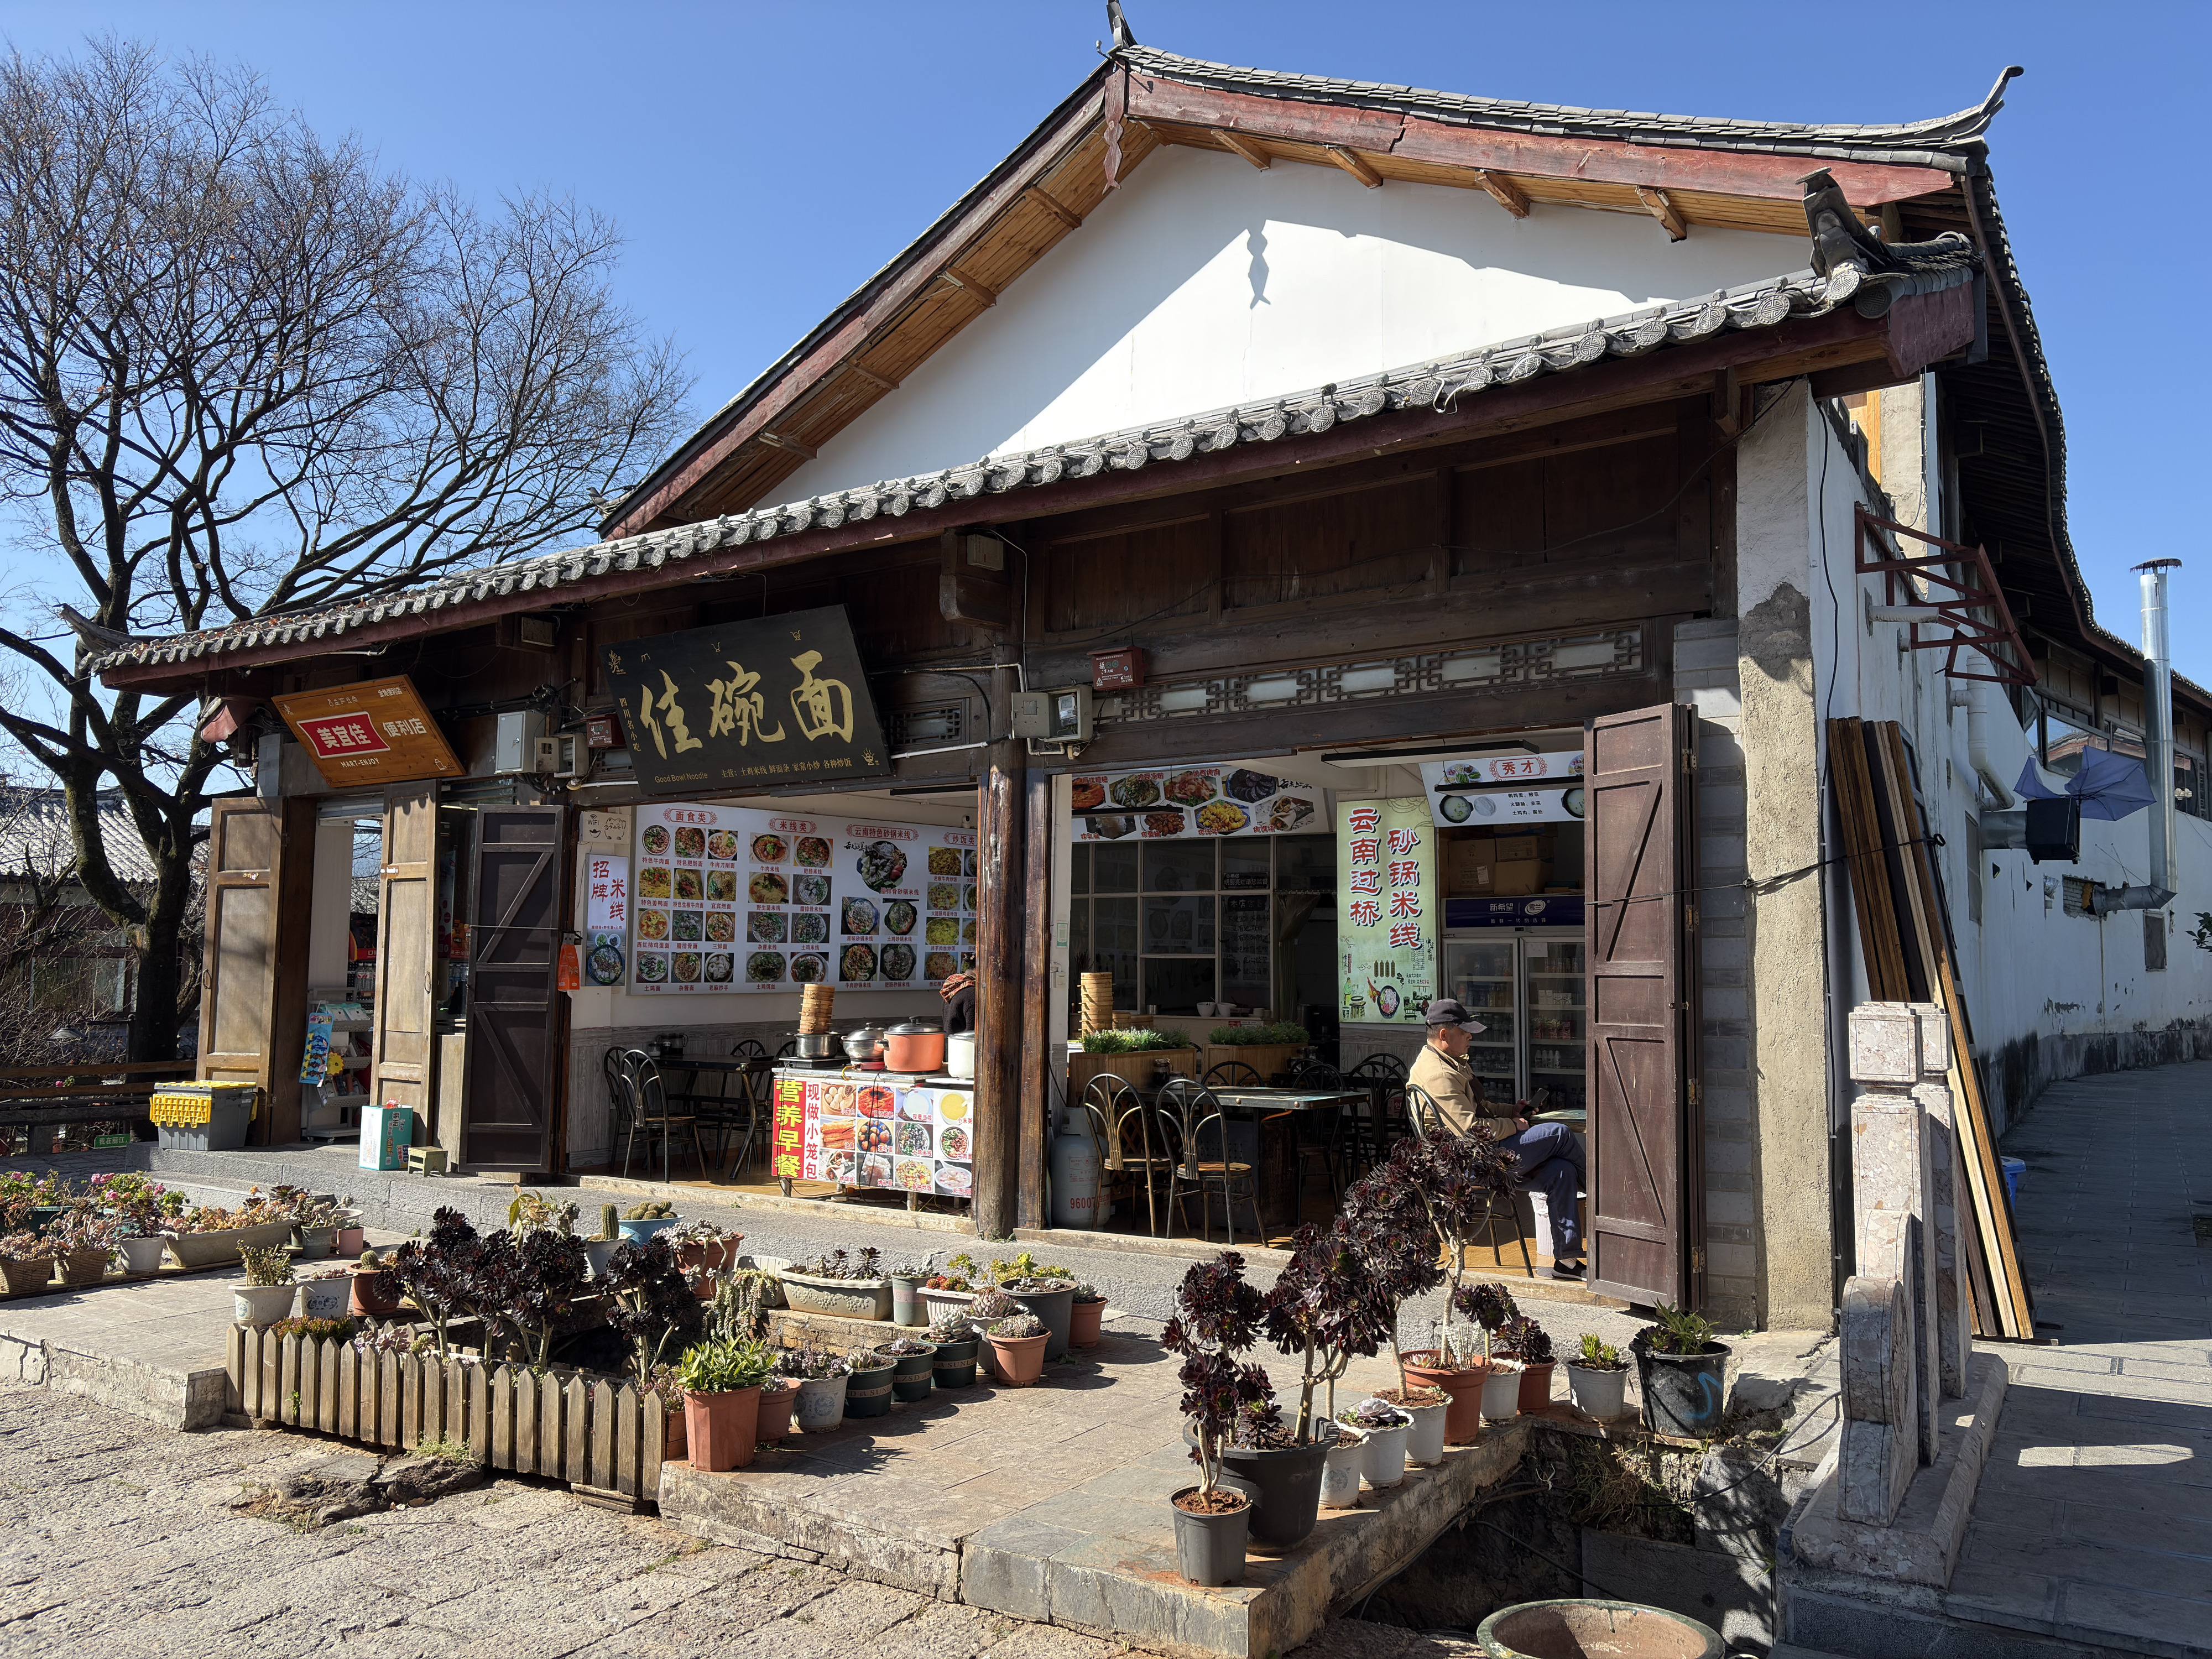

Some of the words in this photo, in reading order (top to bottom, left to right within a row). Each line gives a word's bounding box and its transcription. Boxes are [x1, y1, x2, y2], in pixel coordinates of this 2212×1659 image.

[378, 687, 403, 697] 金角便利店
[640, 650, 853, 760] 佳碗面
[382, 718, 427, 738] 便利店
[619, 697, 641, 753] 四川名小吃
[316, 723, 372, 749] 美宜佳
[340, 757, 380, 768] MART-ENJOY
[740, 766, 768, 777] 土鸡米线
[769, 764, 790, 774] 鲜面条
[792, 761, 820, 773] 家常小炒
[823, 758, 852, 769] 各种炒饭
[1502, 760, 1534, 775] 秀才
[655, 775, 671, 784] Good
[671, 774, 686, 782] Bowl
[687, 773, 708, 781] Noodle
[675, 811, 706, 823] 面食类
[779, 820, 807, 832] 米线类
[855, 827, 911, 839] 云南特色砂锅米线
[952, 834, 975, 845] 炒饭类
[642, 857, 670, 865] 特色牛肉面
[710, 861, 735, 869] 牛肉刀削面
[1348, 806, 1381, 926] 云南过桥
[591, 860, 609, 902] 招牌
[1386, 827, 1422, 949] 砂锅米线
[609, 878, 626, 921] 米线
[1489, 903, 1514, 911] 新希望
[774, 1079, 803, 1178] 营养早餐
[805, 1084, 820, 1180] 现做小笼包
